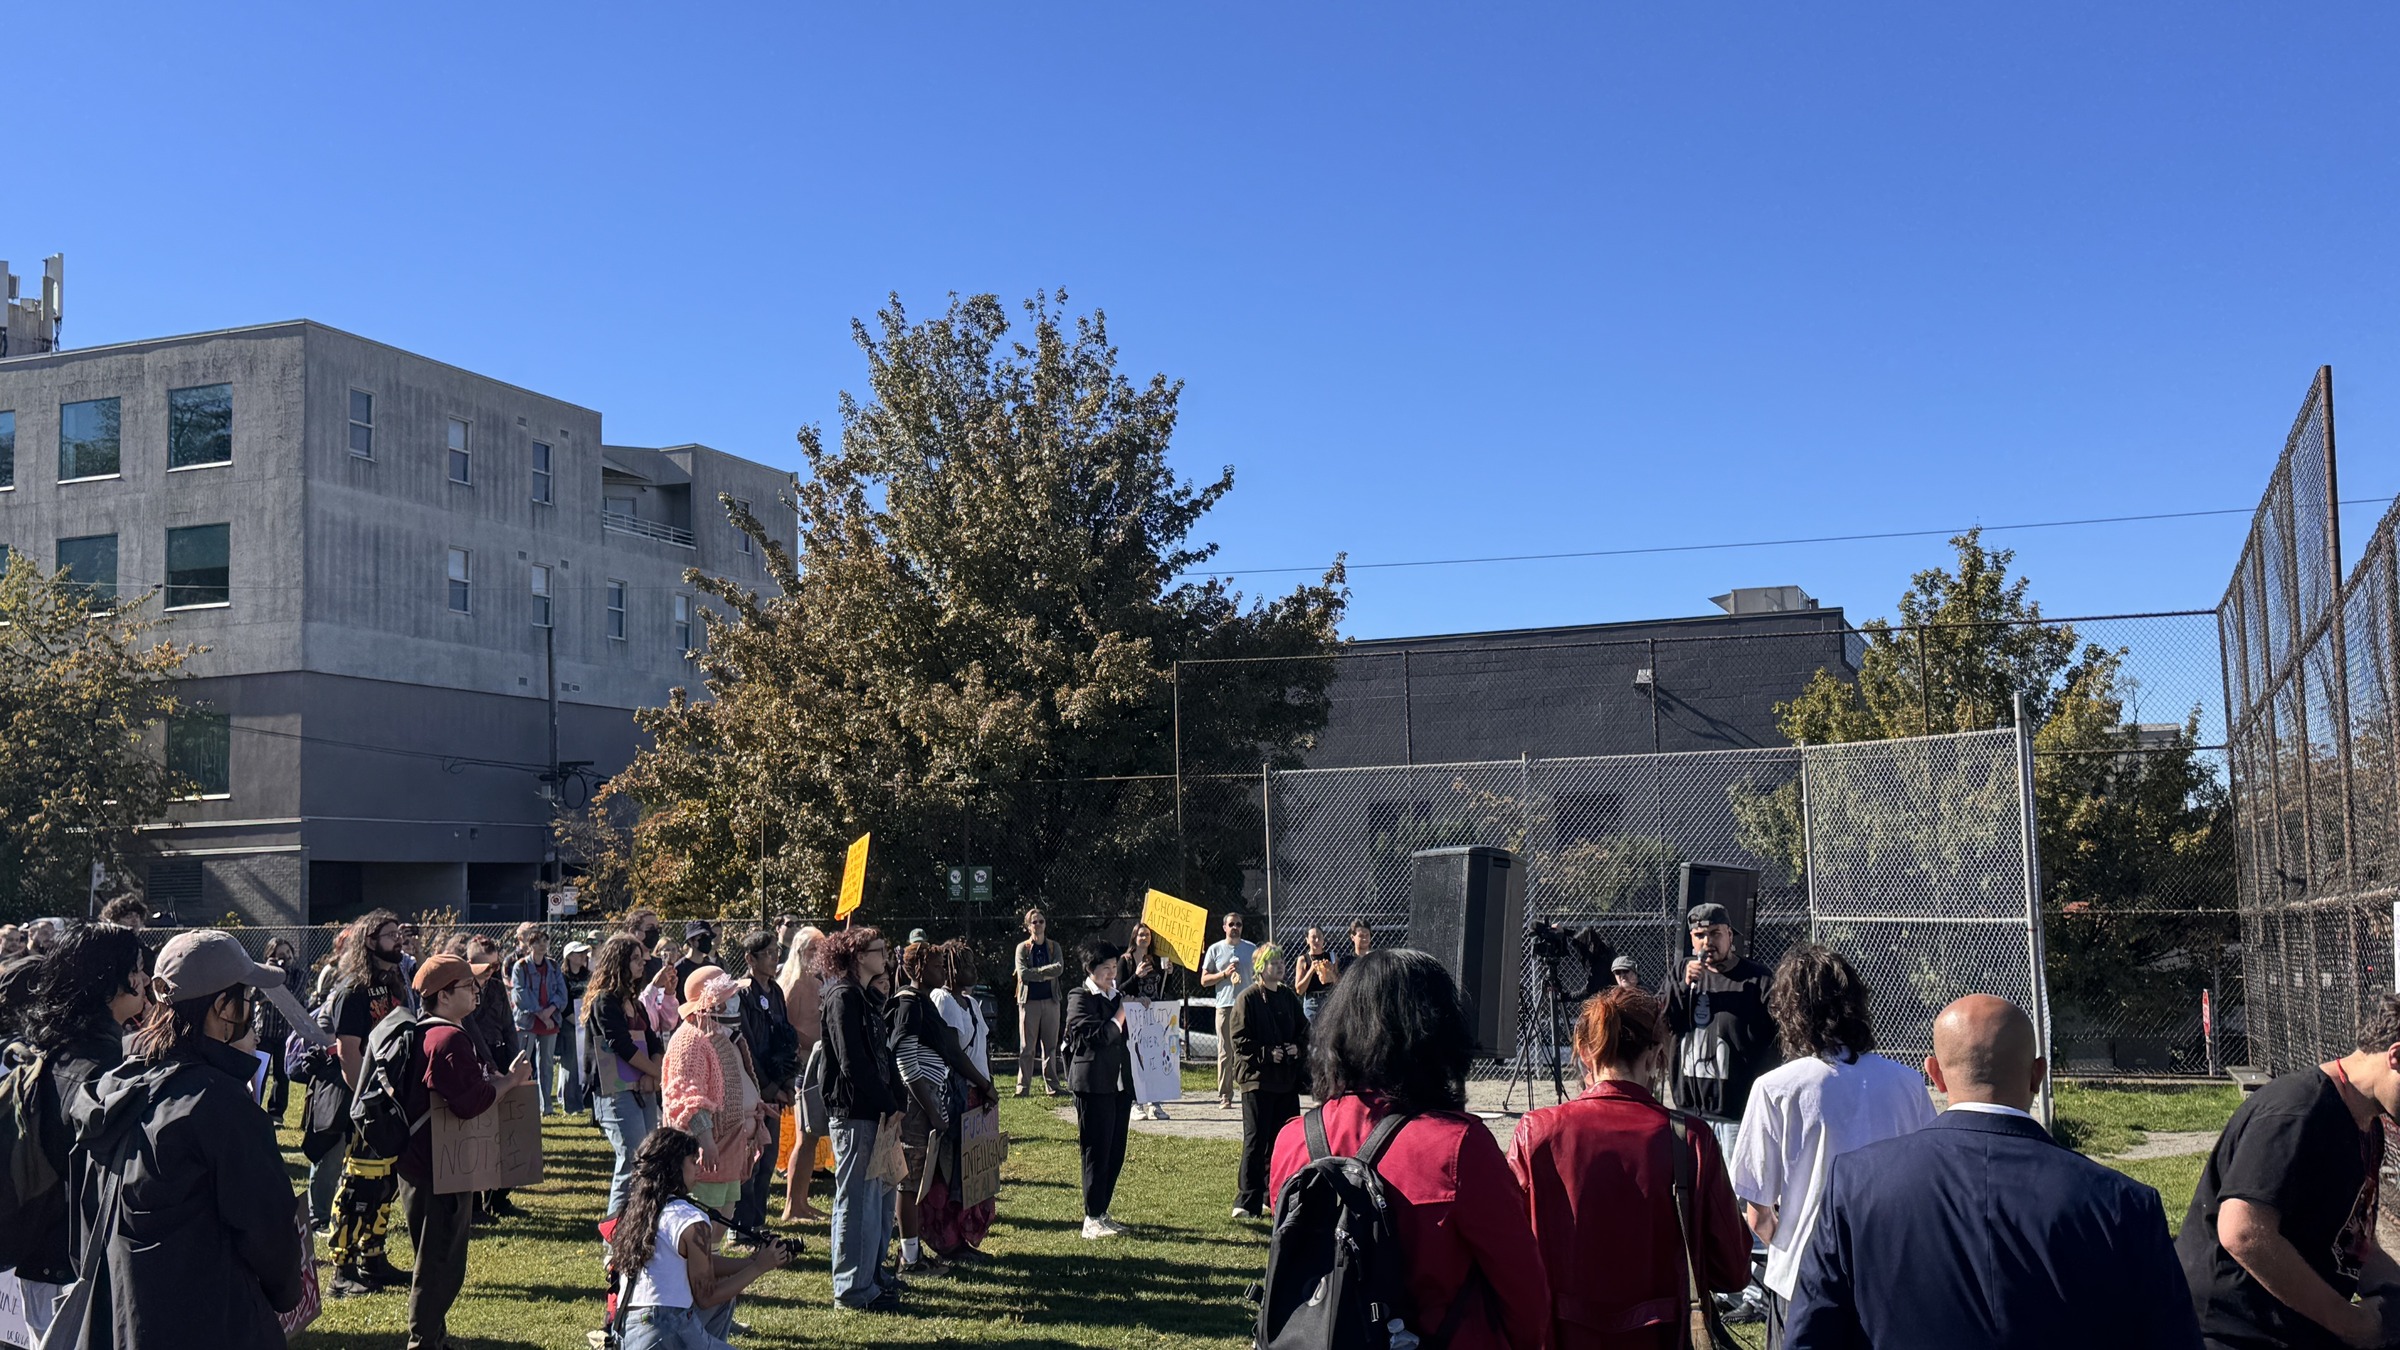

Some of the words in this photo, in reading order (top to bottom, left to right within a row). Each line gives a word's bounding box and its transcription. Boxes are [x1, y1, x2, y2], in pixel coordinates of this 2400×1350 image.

[1154, 897, 1192, 923] CHOOSE
[1147, 911, 1199, 944] AUTHENTIC
[1152, 932, 1198, 966] ELLIGENCE
[502, 1100, 526, 1123] IS
[963, 1111, 988, 1143] FUCK
[439, 1135, 493, 1180] NOT
